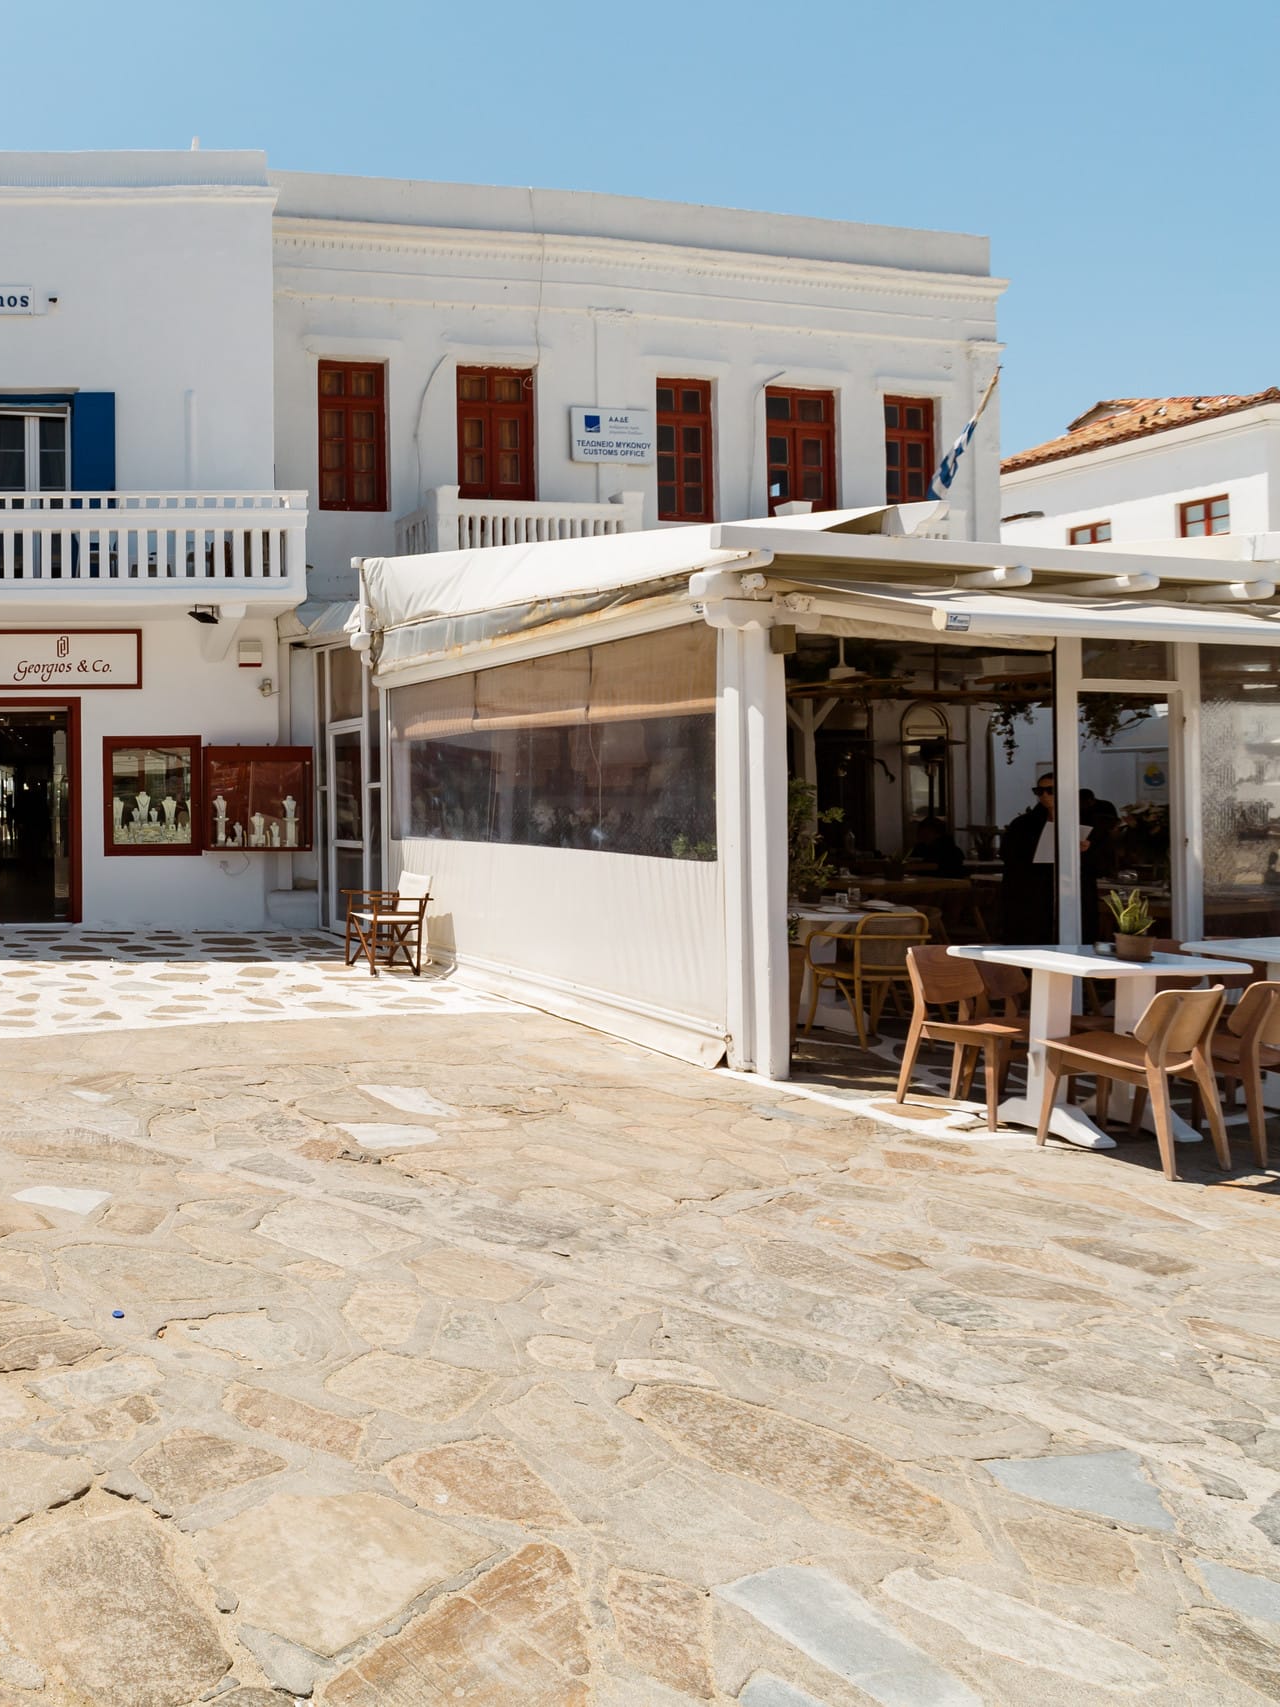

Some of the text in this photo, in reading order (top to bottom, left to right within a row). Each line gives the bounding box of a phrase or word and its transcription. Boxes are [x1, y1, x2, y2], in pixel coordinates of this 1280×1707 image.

[577, 440, 651, 449] ΤΕΛΩΝΕΙΟ ΜΥΚΟΝΟΥ
[583, 448, 646, 457] CUSTOMS OFFICE
[13, 659, 112, 682] Georgios & Co.
